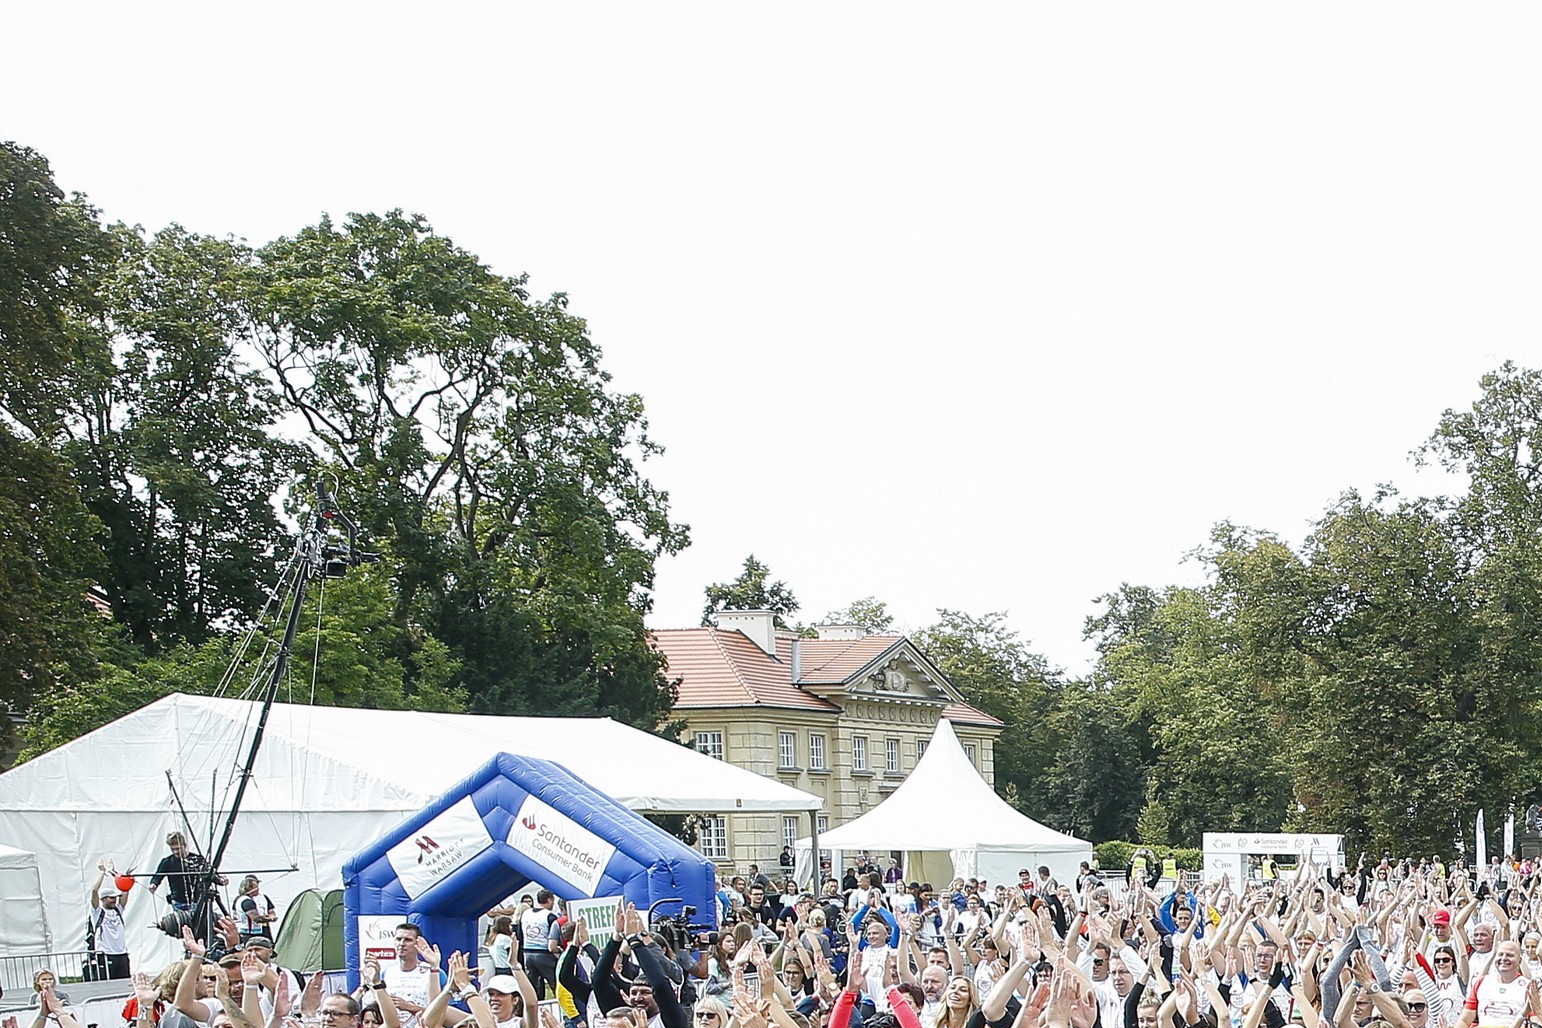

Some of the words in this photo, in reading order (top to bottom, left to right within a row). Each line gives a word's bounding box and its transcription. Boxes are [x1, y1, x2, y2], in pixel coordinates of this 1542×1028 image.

[425, 838, 464, 868] MARRIOTT
[532, 838, 573, 871] Consumer
[571, 863, 593, 883] Bank
[537, 824, 600, 870] Santander
[430, 851, 463, 877] WARSAW
[578, 904, 616, 930] STREF
